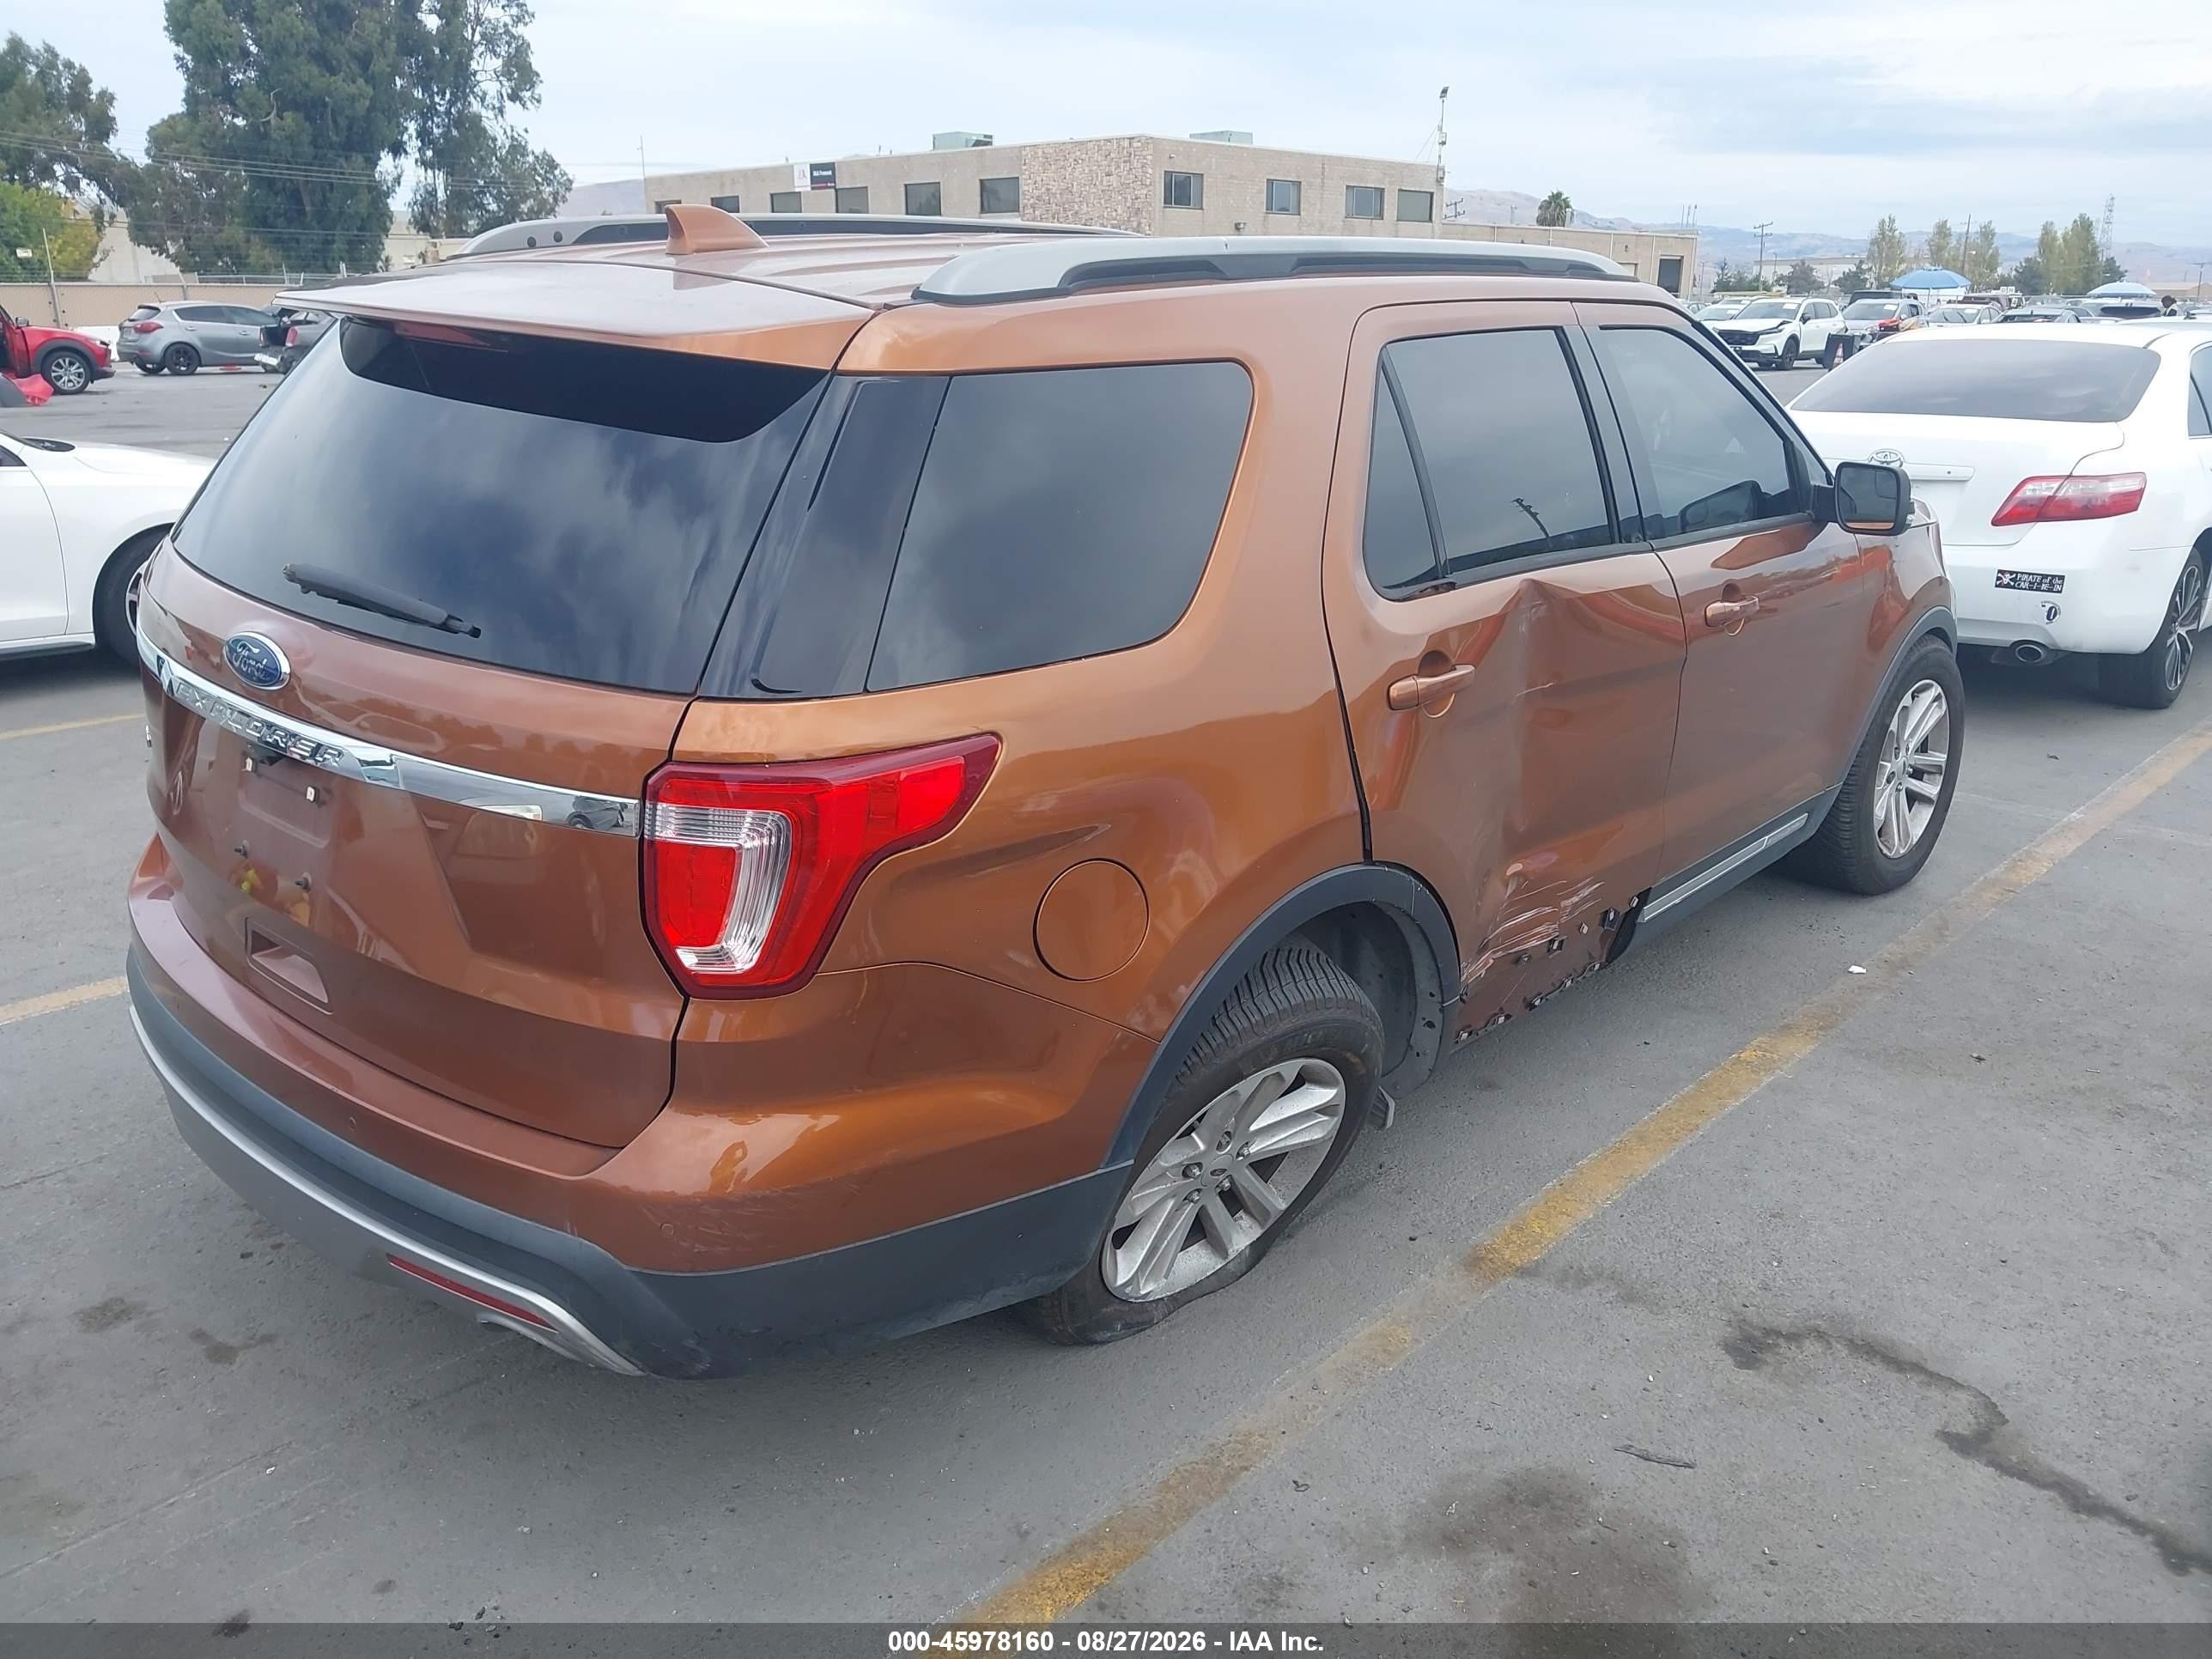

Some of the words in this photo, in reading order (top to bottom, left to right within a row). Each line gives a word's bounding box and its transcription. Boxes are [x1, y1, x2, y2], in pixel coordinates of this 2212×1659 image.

[2017, 574, 2042, 582] PIRATE
[228, 637, 276, 681] Ford
[176, 682, 344, 767] EXPLORER
